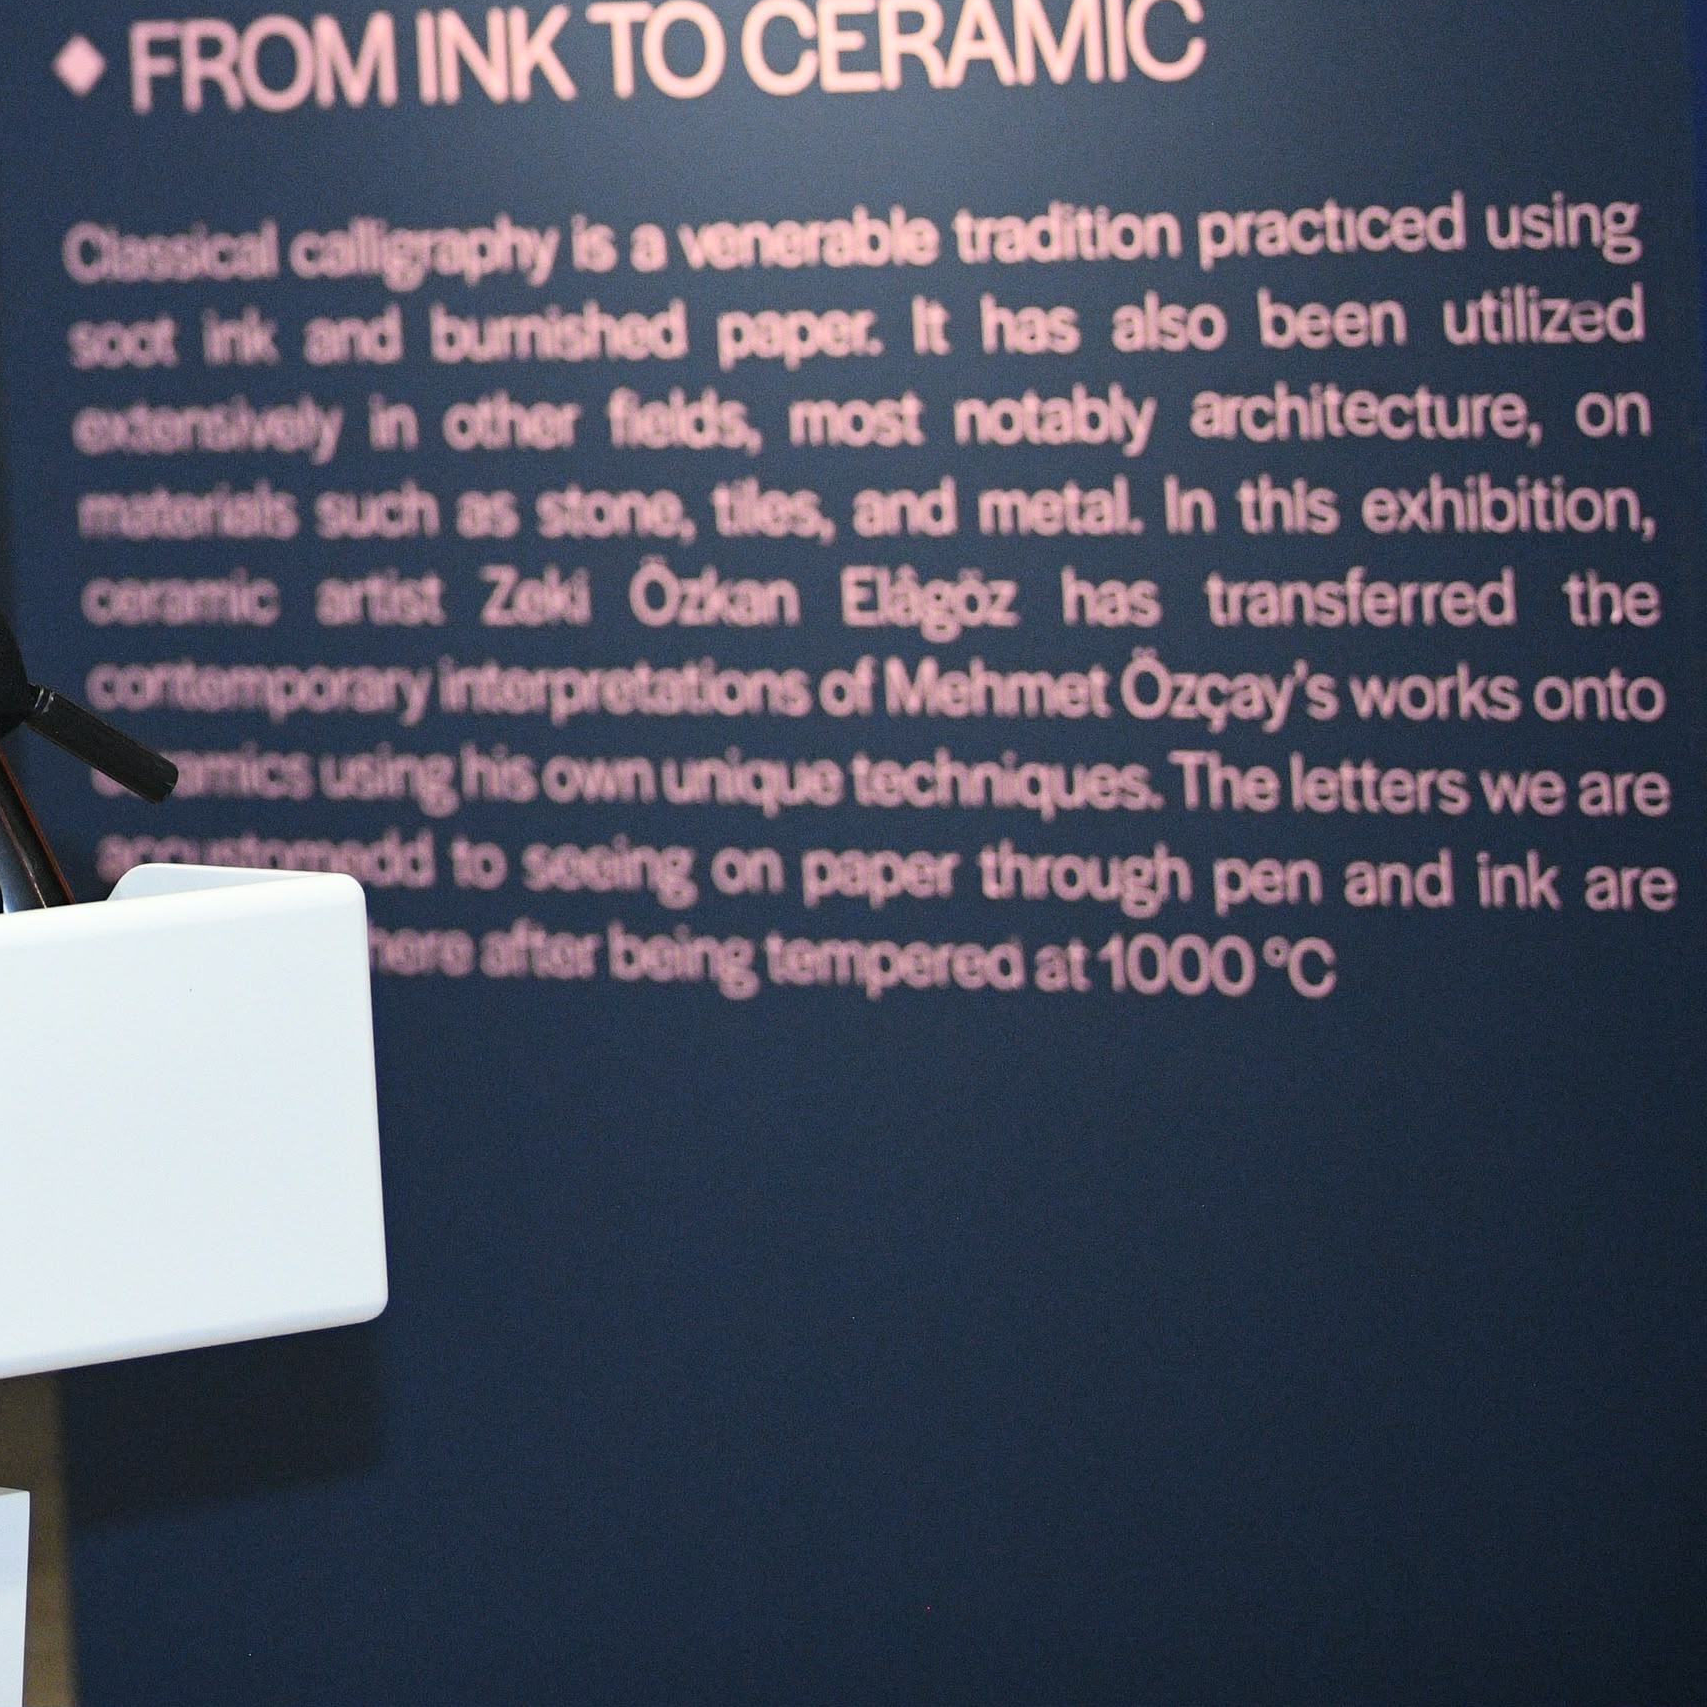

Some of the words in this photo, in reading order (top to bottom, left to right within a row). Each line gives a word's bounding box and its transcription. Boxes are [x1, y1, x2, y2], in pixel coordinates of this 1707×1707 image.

[130, 11, 398, 112] FROM
[416, 5, 577, 104] INK
[953, 202, 1182, 264] tradition
[1485, 192, 1642, 264] using
[912, 296, 950, 355] It
[980, 294, 1081, 354] has
[1112, 291, 1227, 352] also
[1257, 288, 1407, 349] been
[1443, 283, 1645, 346] utilized
[789, 392, 924, 447] most
[954, 384, 1156, 457] notably
[1190, 382, 1542, 444] architecture,
[1576, 391, 1651, 438] on
[853, 476, 957, 537] and
[978, 476, 1143, 536] metal.
[1164, 475, 1216, 533] In
[1237, 474, 1339, 534] this
[1362, 473, 1655, 539] exhibition,
[1061, 567, 1162, 627] has
[1205, 566, 1516, 627] transferred
[1564, 572, 1660, 627] the
[820, 655, 874, 717] of
[885, 656, 1110, 718] Mehmet
[1350, 663, 1521, 721] works
[1534, 668, 1666, 722] onto
[851, 749, 1163, 819] techniques.
[1171, 750, 1280, 812] The
[1290, 753, 1470, 815] letters
[1480, 770, 1566, 815] we
[1579, 771, 1671, 817] are
[802, 849, 959, 906] paper
[979, 840, 1192, 915] through
[1213, 858, 1322, 915] pen
[1345, 849, 1453, 908] and
[1478, 851, 1560, 908] ink
[1585, 865, 1677, 912] are
[1035, 939, 1089, 992] at
